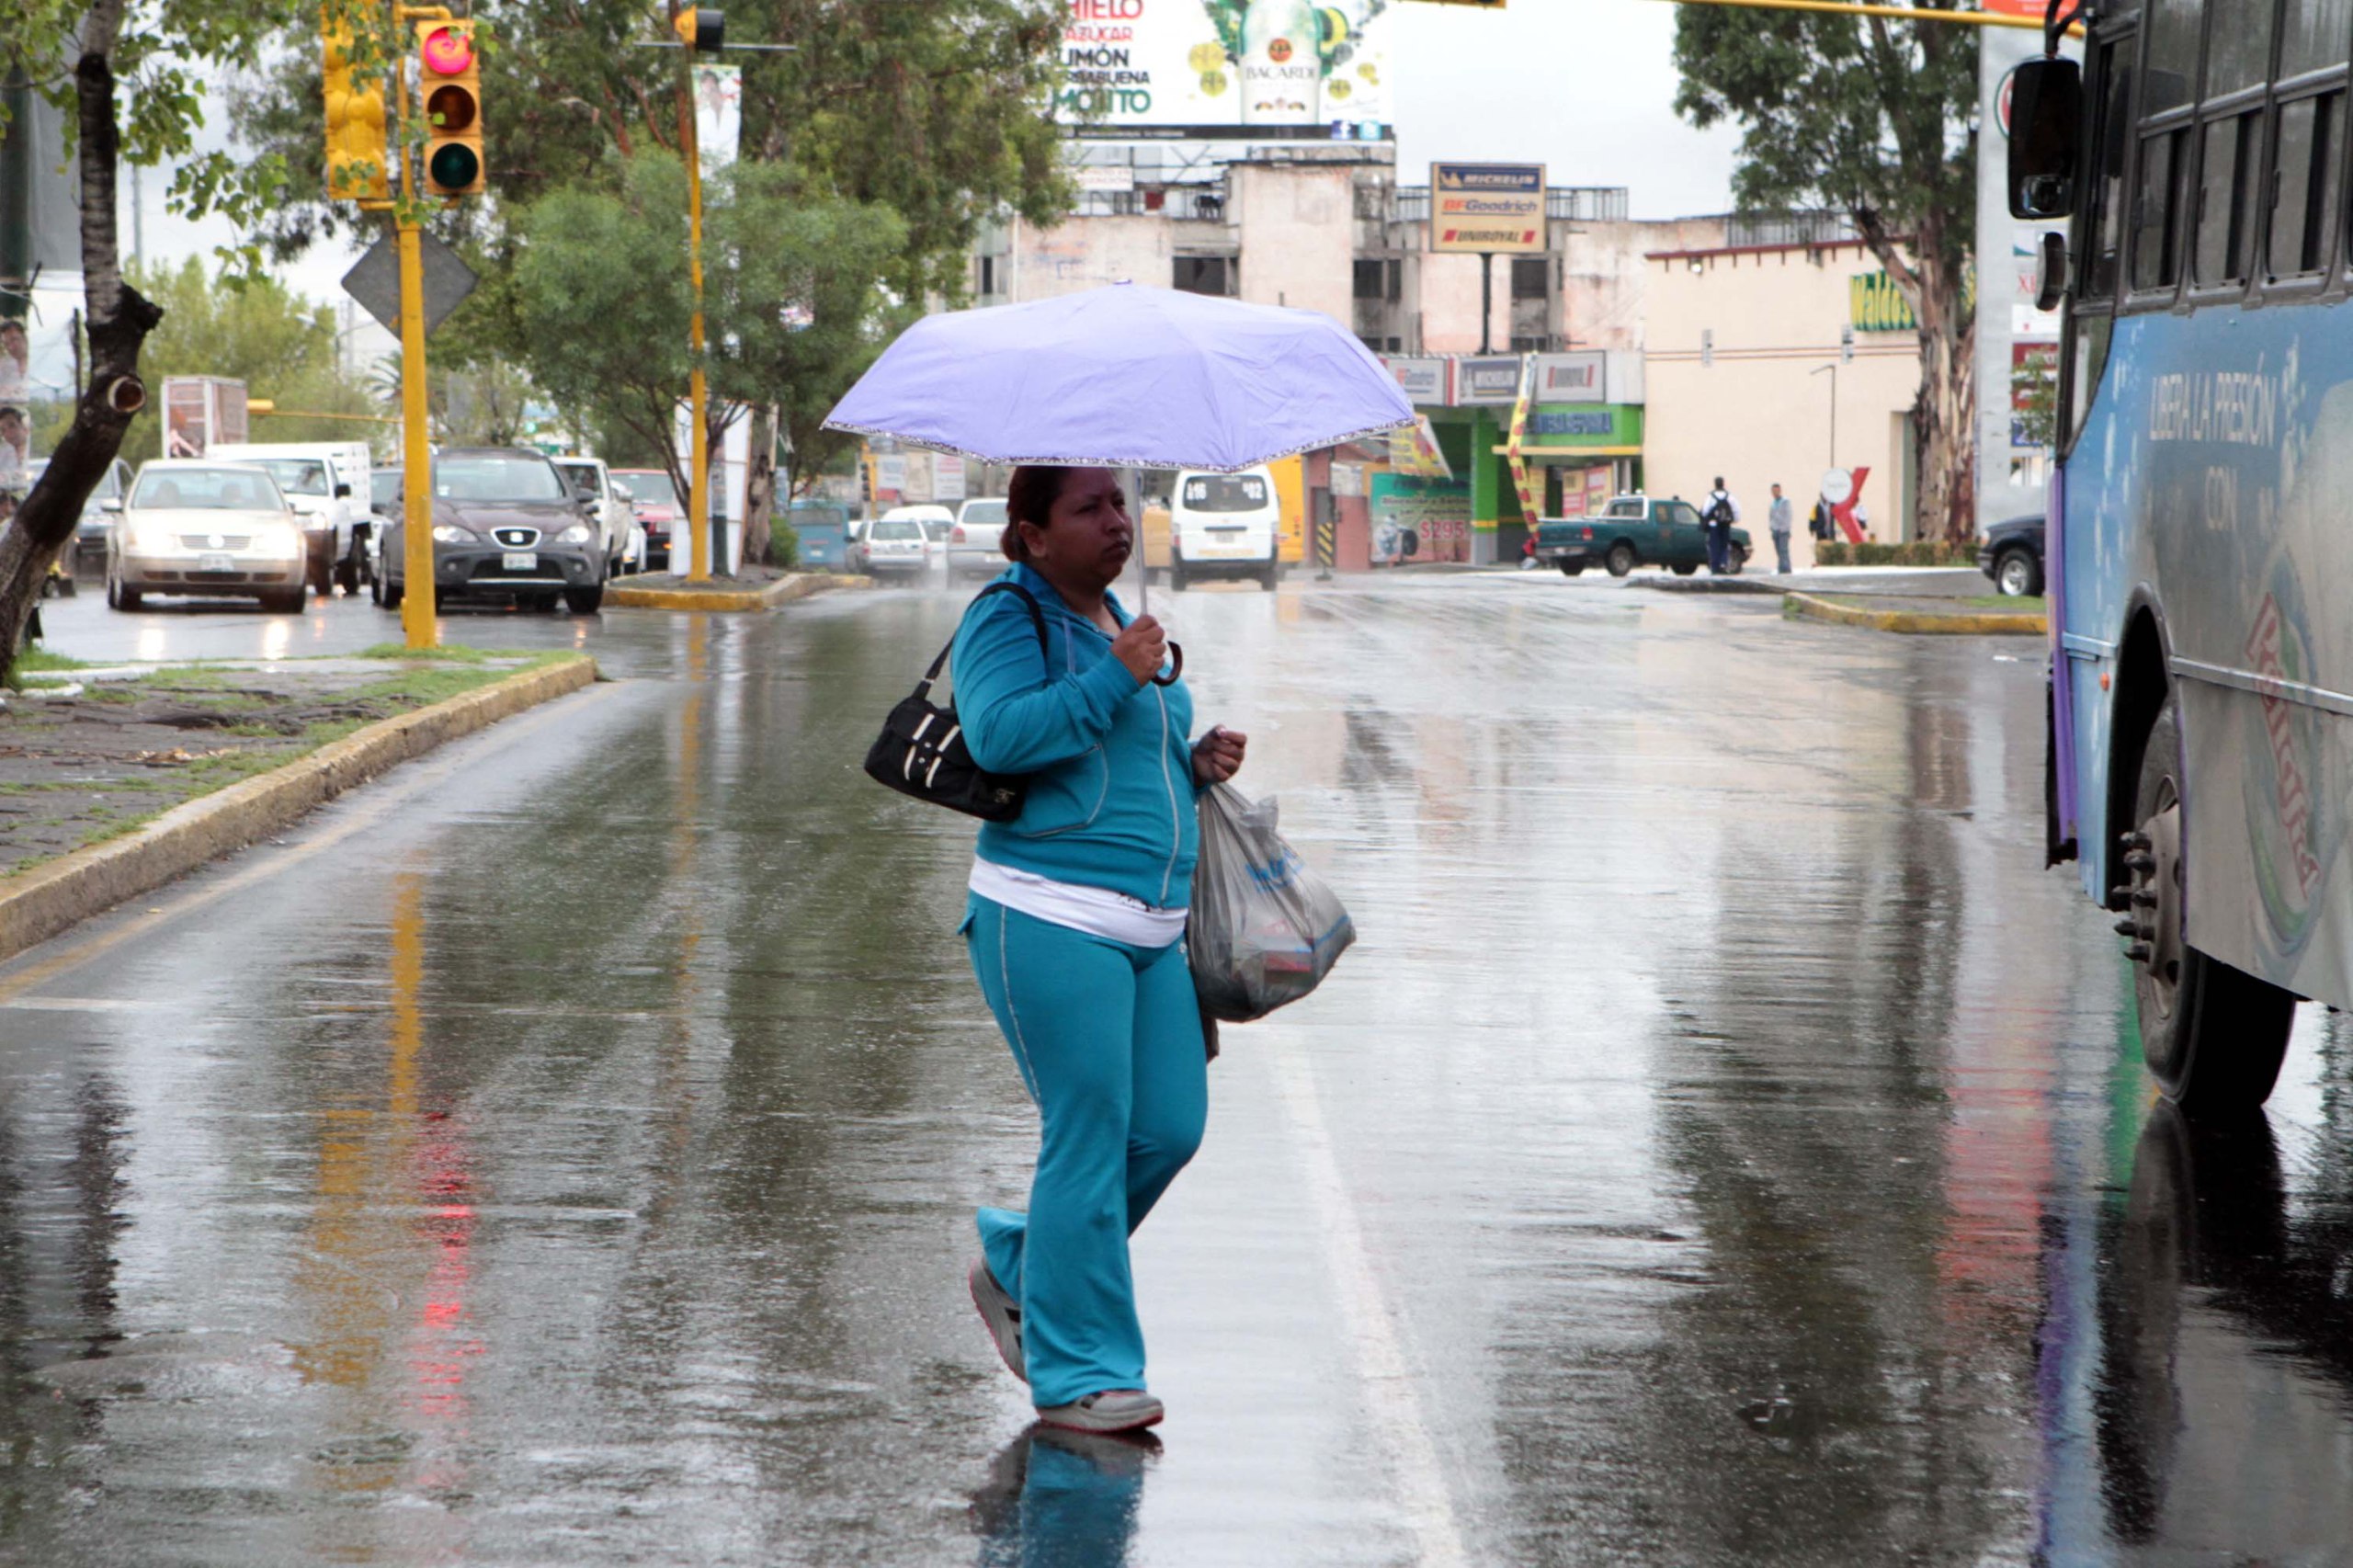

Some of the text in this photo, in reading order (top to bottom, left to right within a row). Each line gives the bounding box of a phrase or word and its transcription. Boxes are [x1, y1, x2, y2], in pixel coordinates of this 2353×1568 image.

[1463, 173, 1536, 185] MICHELIN
[1443, 199, 1538, 213] BFGoodrich
[1457, 230, 1520, 244] UNIROYAL
[2150, 351, 2278, 448] LIBERA LA PRESIÓN
[2205, 465, 2238, 531] CON
